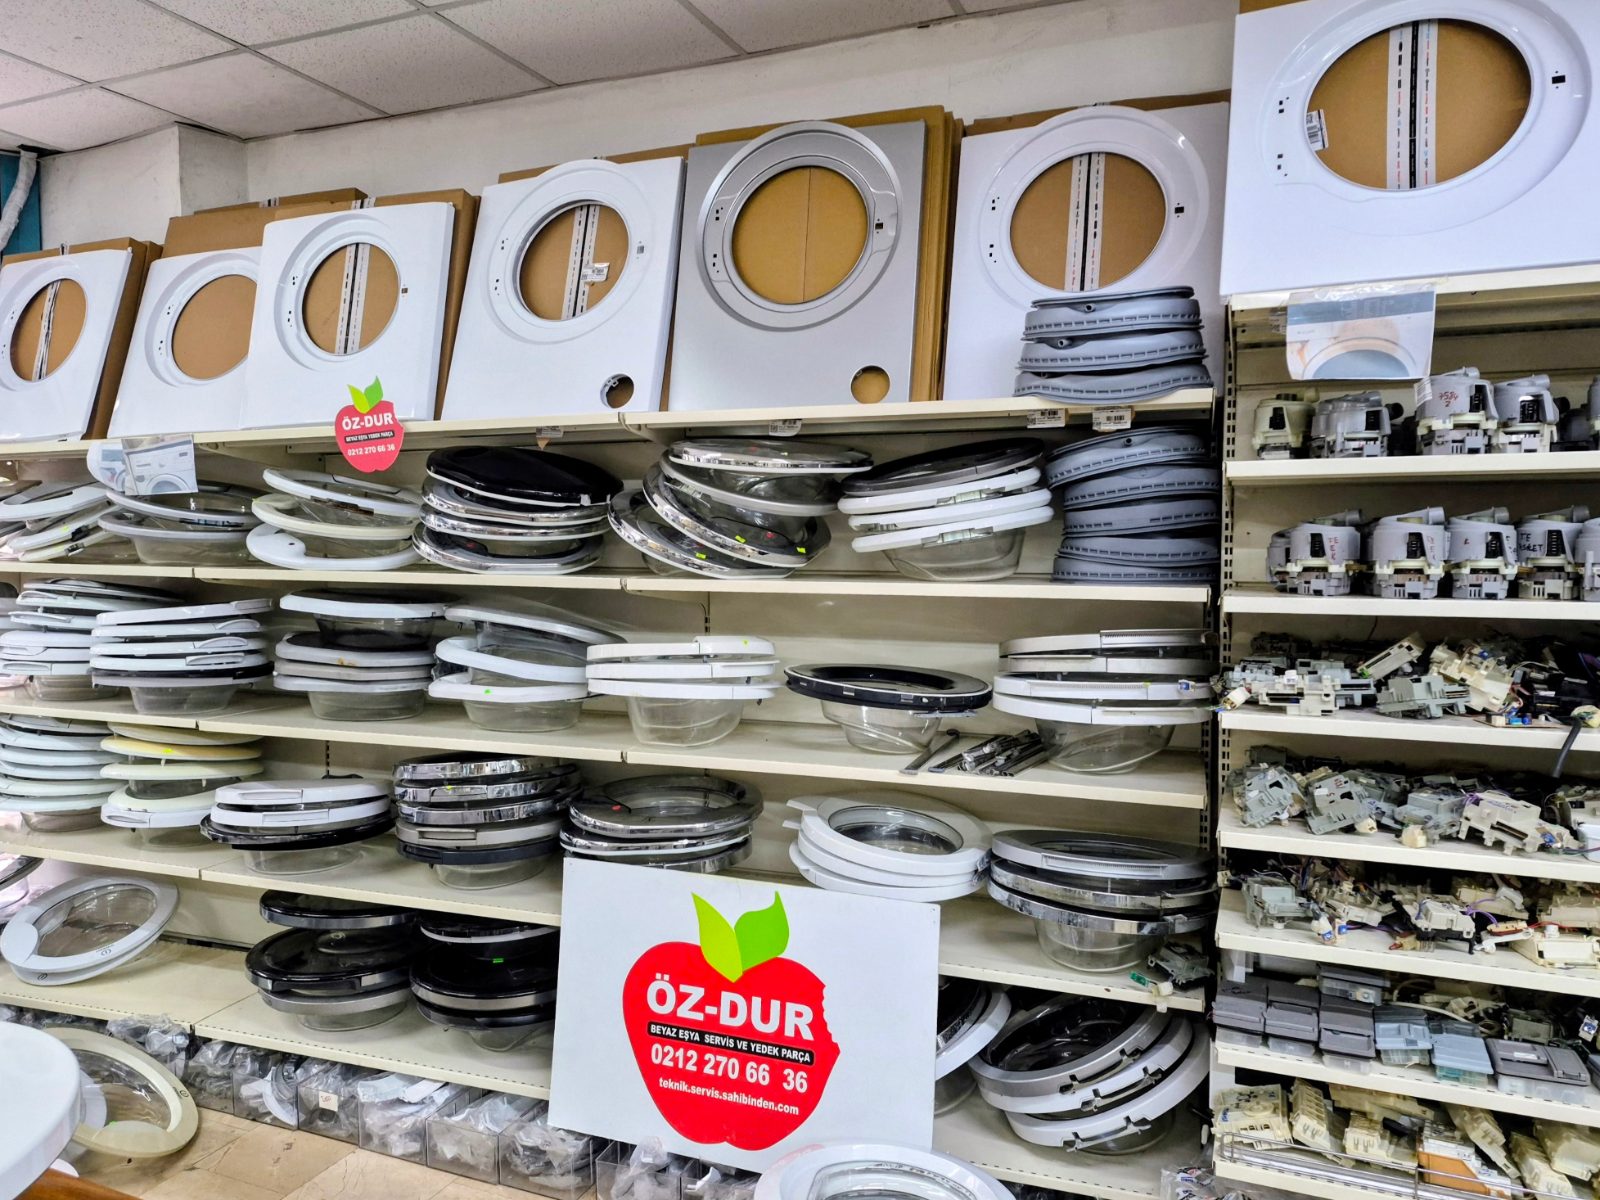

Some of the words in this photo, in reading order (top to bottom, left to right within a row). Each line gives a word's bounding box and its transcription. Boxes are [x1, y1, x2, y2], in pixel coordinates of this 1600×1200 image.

[342, 413, 393, 430] ÖZ-DUR
[348, 448, 363, 456] 0212
[365, 447, 376, 455] 270
[647, 973, 814, 1041] ÖZ-DUR
[650, 1024, 677, 1039] BEYAZ
[679, 1028, 700, 1043] EŞYA
[704, 1032, 734, 1048] SERVİS
[736, 1039, 748, 1051] VE
[750, 1042, 779, 1057] YEDEK
[781, 1047, 810, 1064] PARÇA
[651, 1043, 697, 1072] 0212
[704, 1052, 739, 1080] 270
[745, 1060, 769, 1086] 66
[783, 1067, 807, 1093] 36
[659, 1077, 799, 1115] teknik.servis.sahibinden.com
